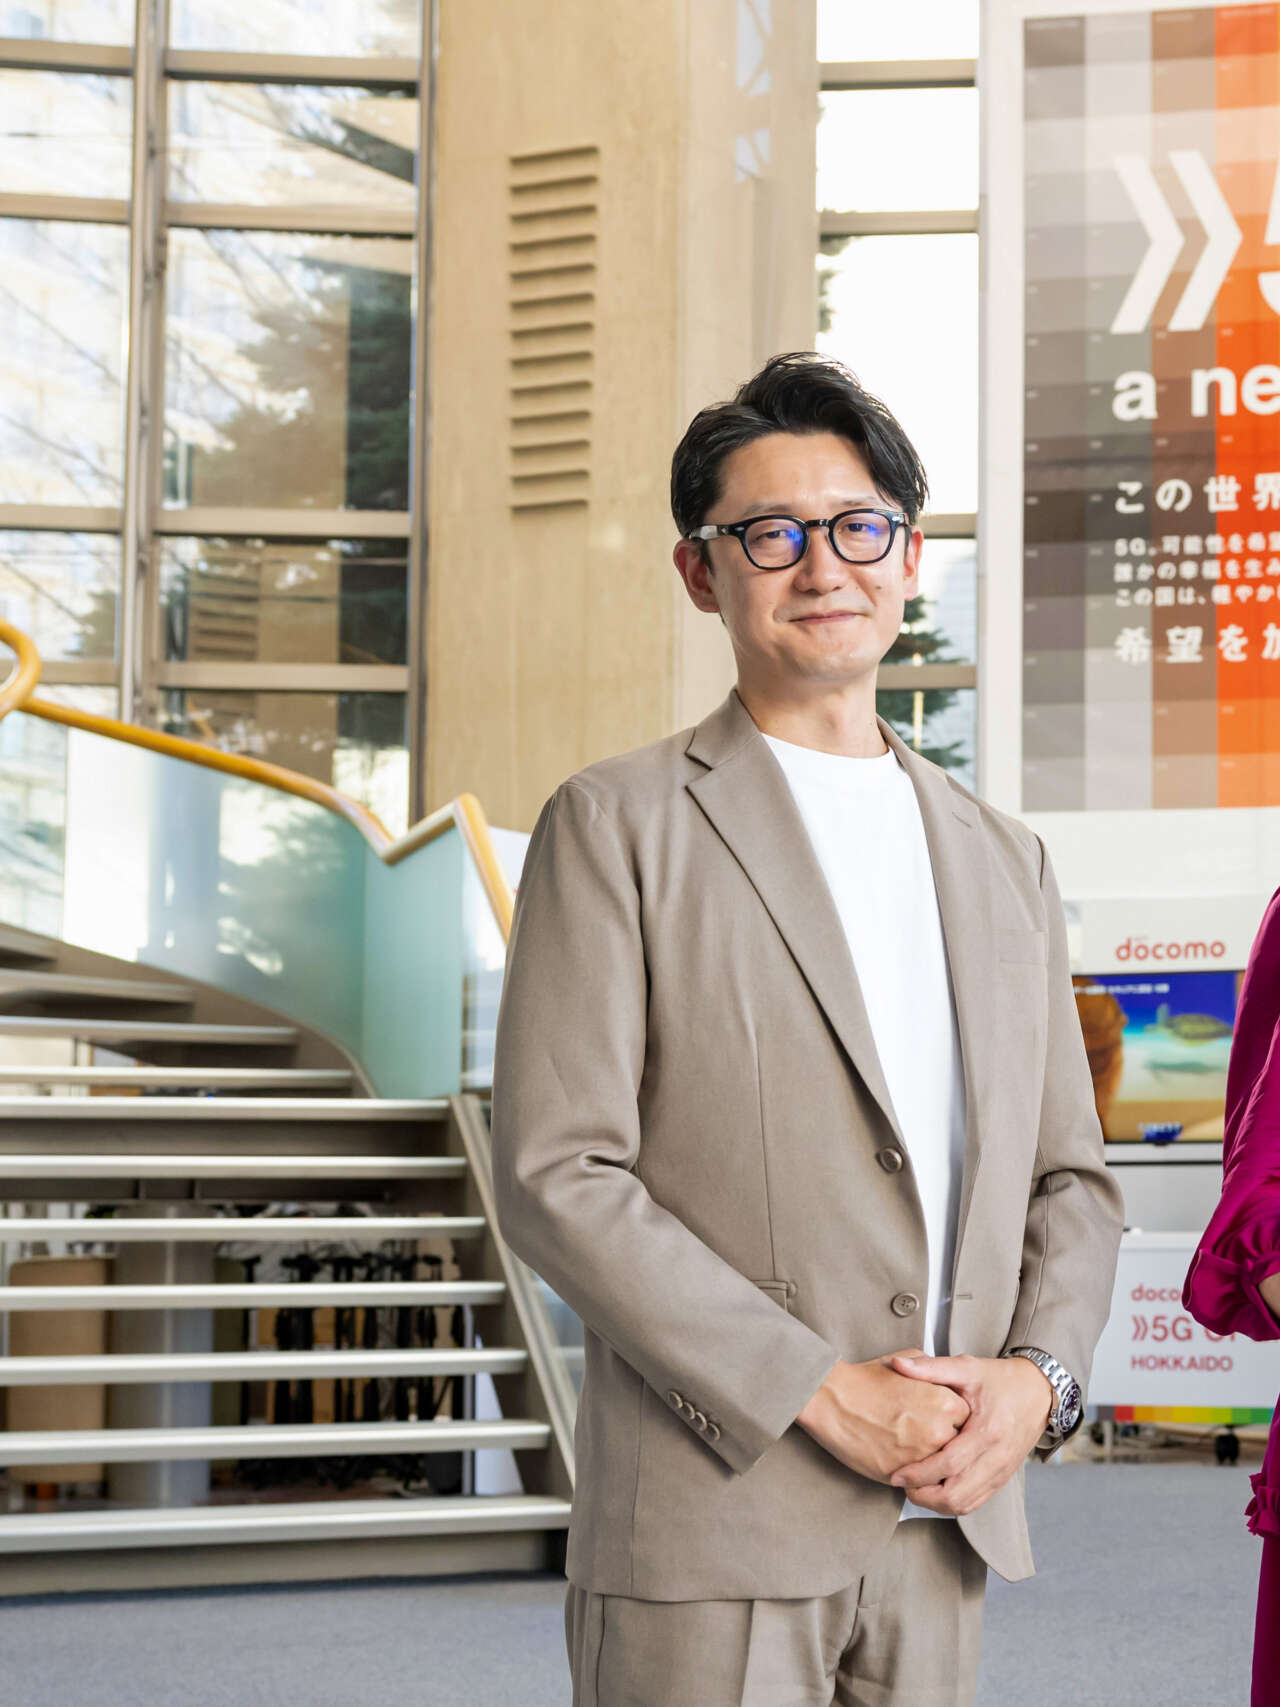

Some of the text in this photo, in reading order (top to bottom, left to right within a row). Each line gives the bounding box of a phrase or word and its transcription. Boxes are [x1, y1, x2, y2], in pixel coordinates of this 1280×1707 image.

[1112, 369, 1158, 421] a
[1115, 938, 1226, 962] docomo
[1131, 1284, 1182, 1302] doco
[1131, 1355, 1234, 1373] HOKKAIDO
